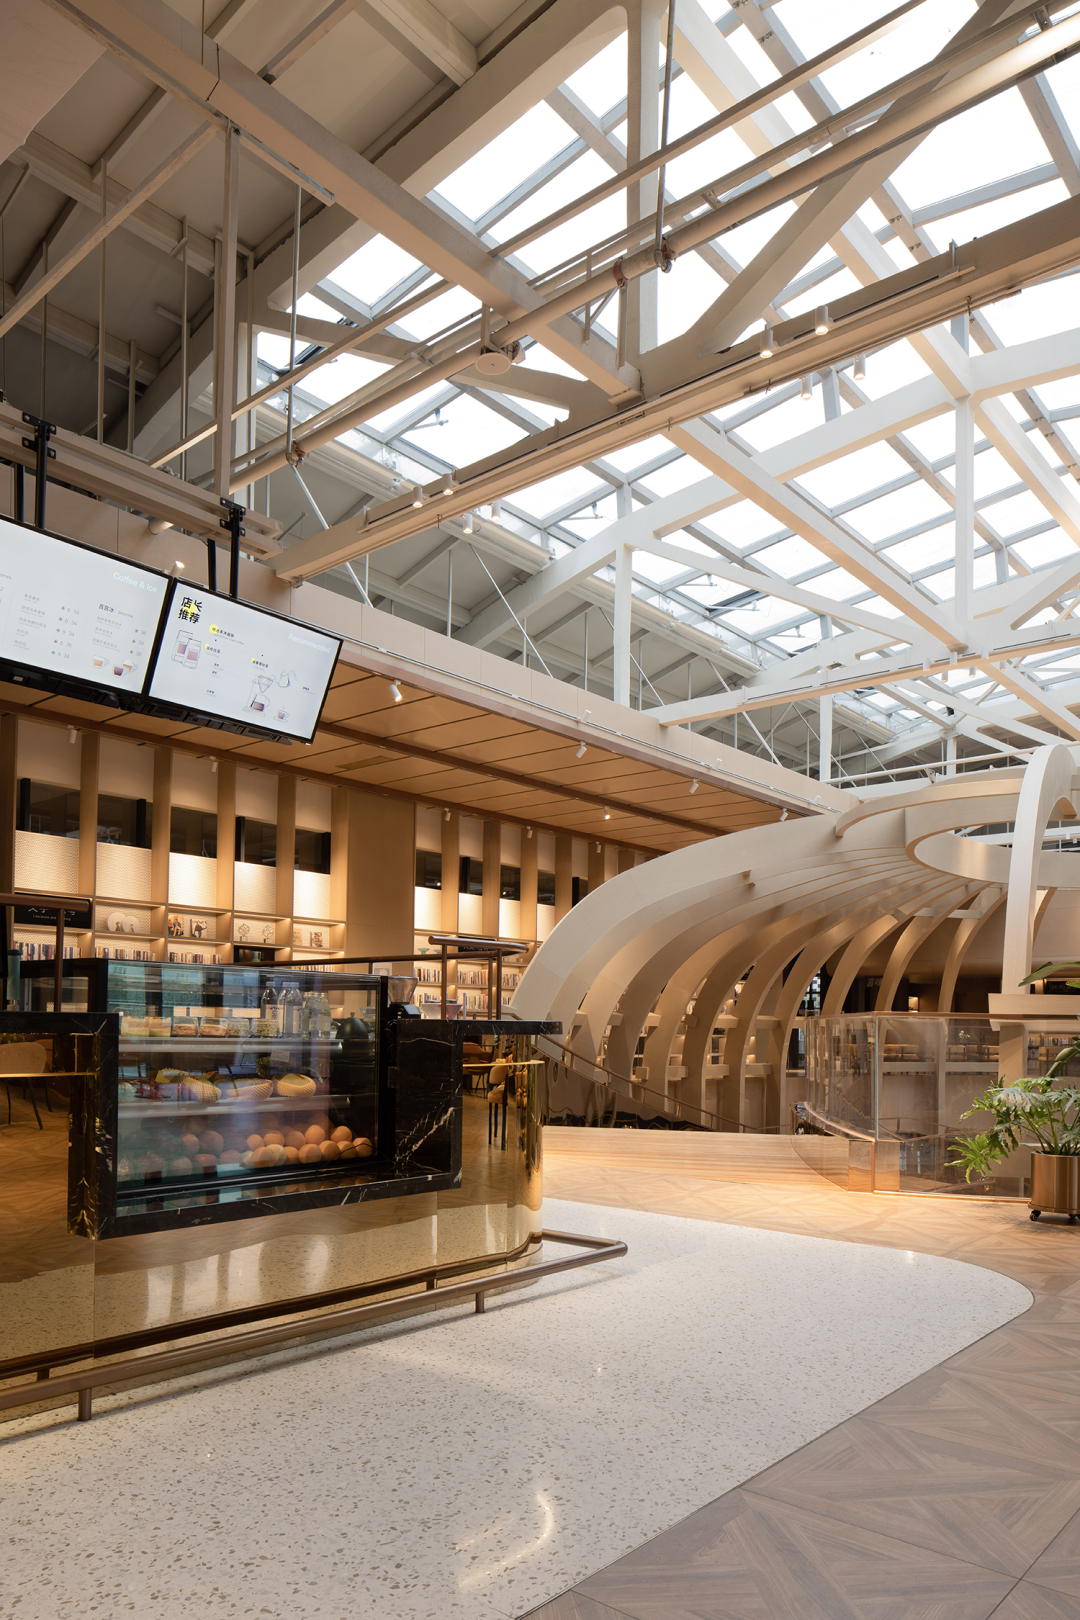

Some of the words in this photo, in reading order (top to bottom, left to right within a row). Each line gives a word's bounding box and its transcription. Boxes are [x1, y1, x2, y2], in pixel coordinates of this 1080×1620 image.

[112, 571, 138, 587] Coffee
[138, 580, 145, 589] &
[146, 583, 158, 593] Ice
[181, 596, 203, 612] 店长
[177, 607, 201, 624] 推荐
[287, 632, 331, 654] Recommended
